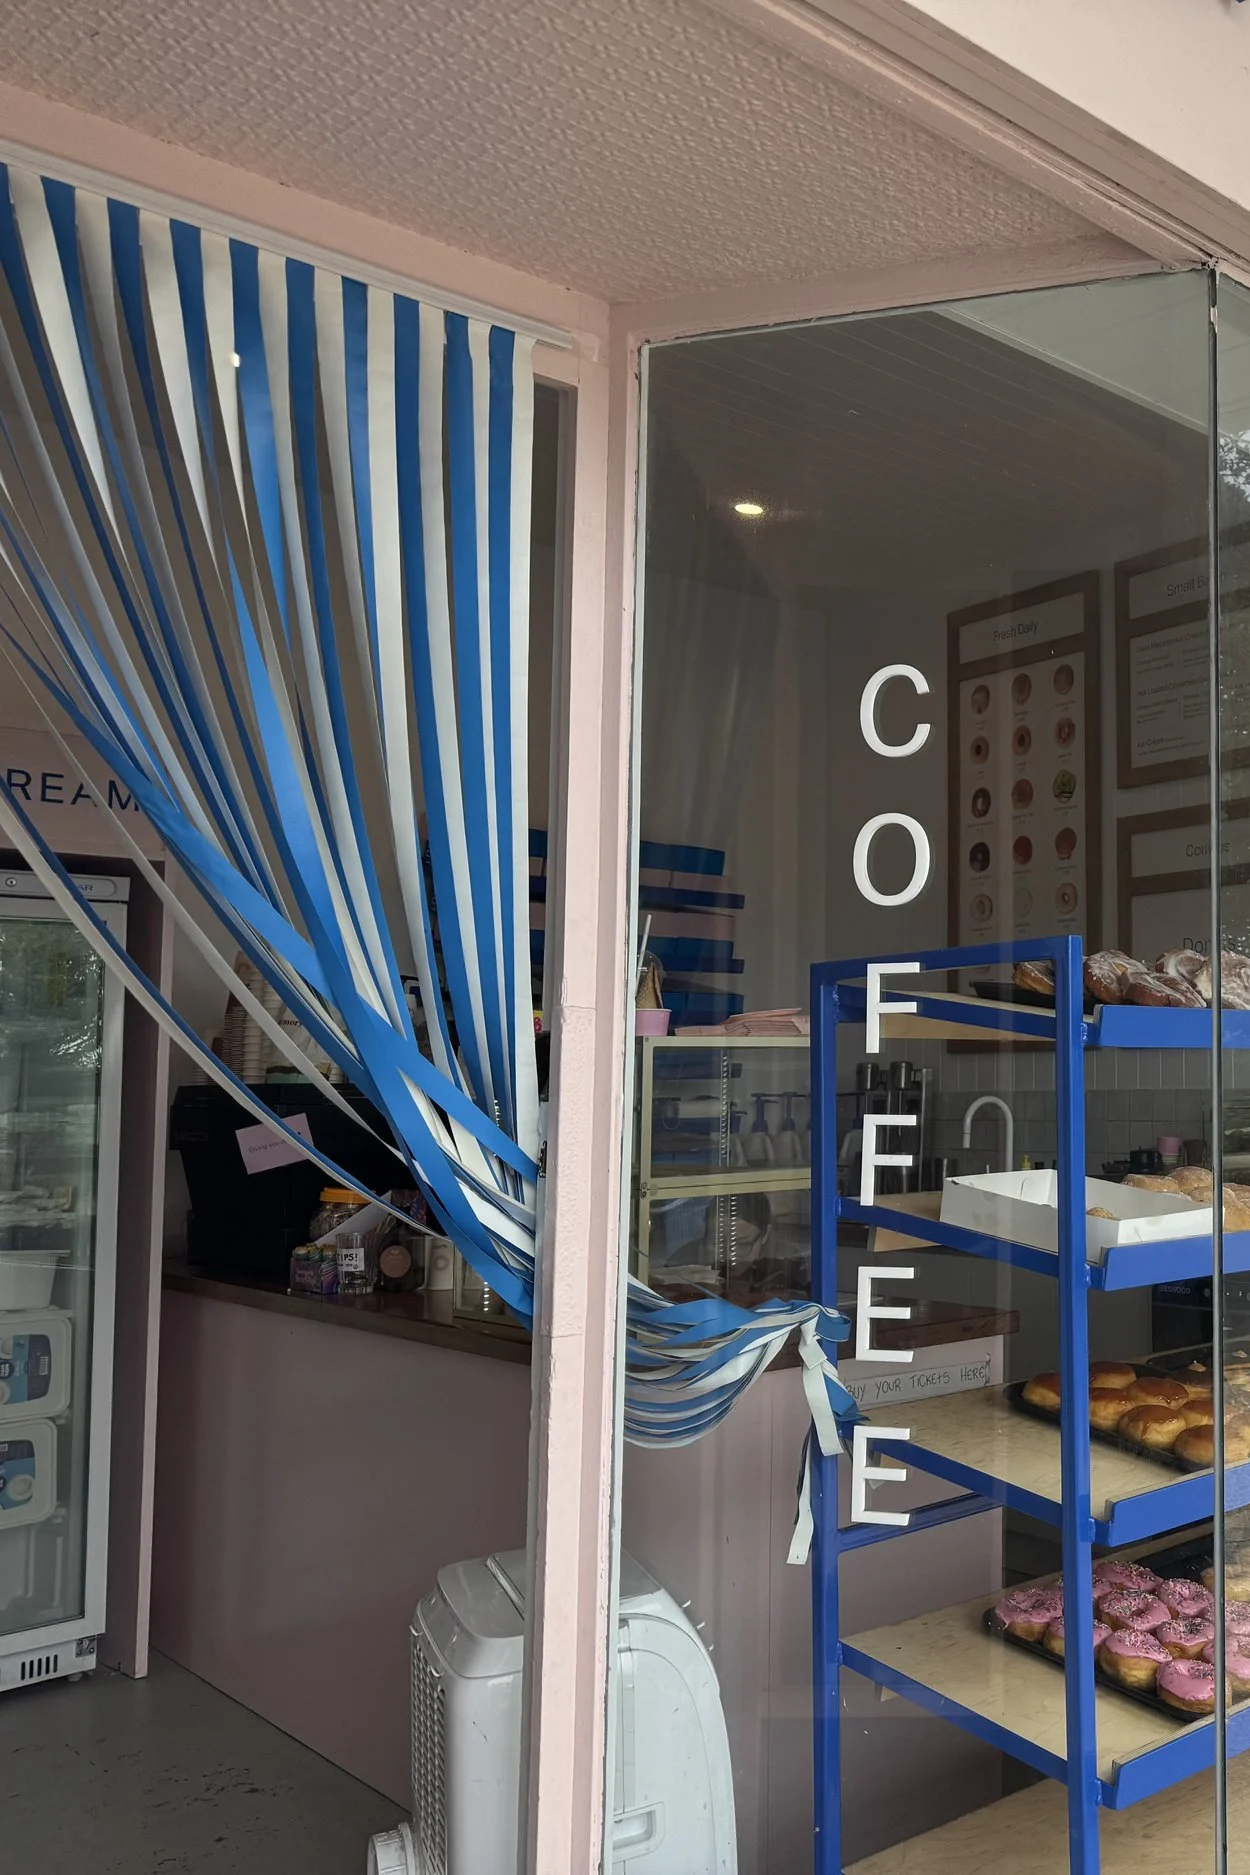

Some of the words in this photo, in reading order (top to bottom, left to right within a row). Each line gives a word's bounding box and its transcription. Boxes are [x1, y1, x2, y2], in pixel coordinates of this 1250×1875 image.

[993, 626, 1017, 642] Fresh
[1018, 620, 1039, 635] Daily
[851, 663, 931, 1527] COFFEE
[875, 1378, 902, 1399] YOUR
